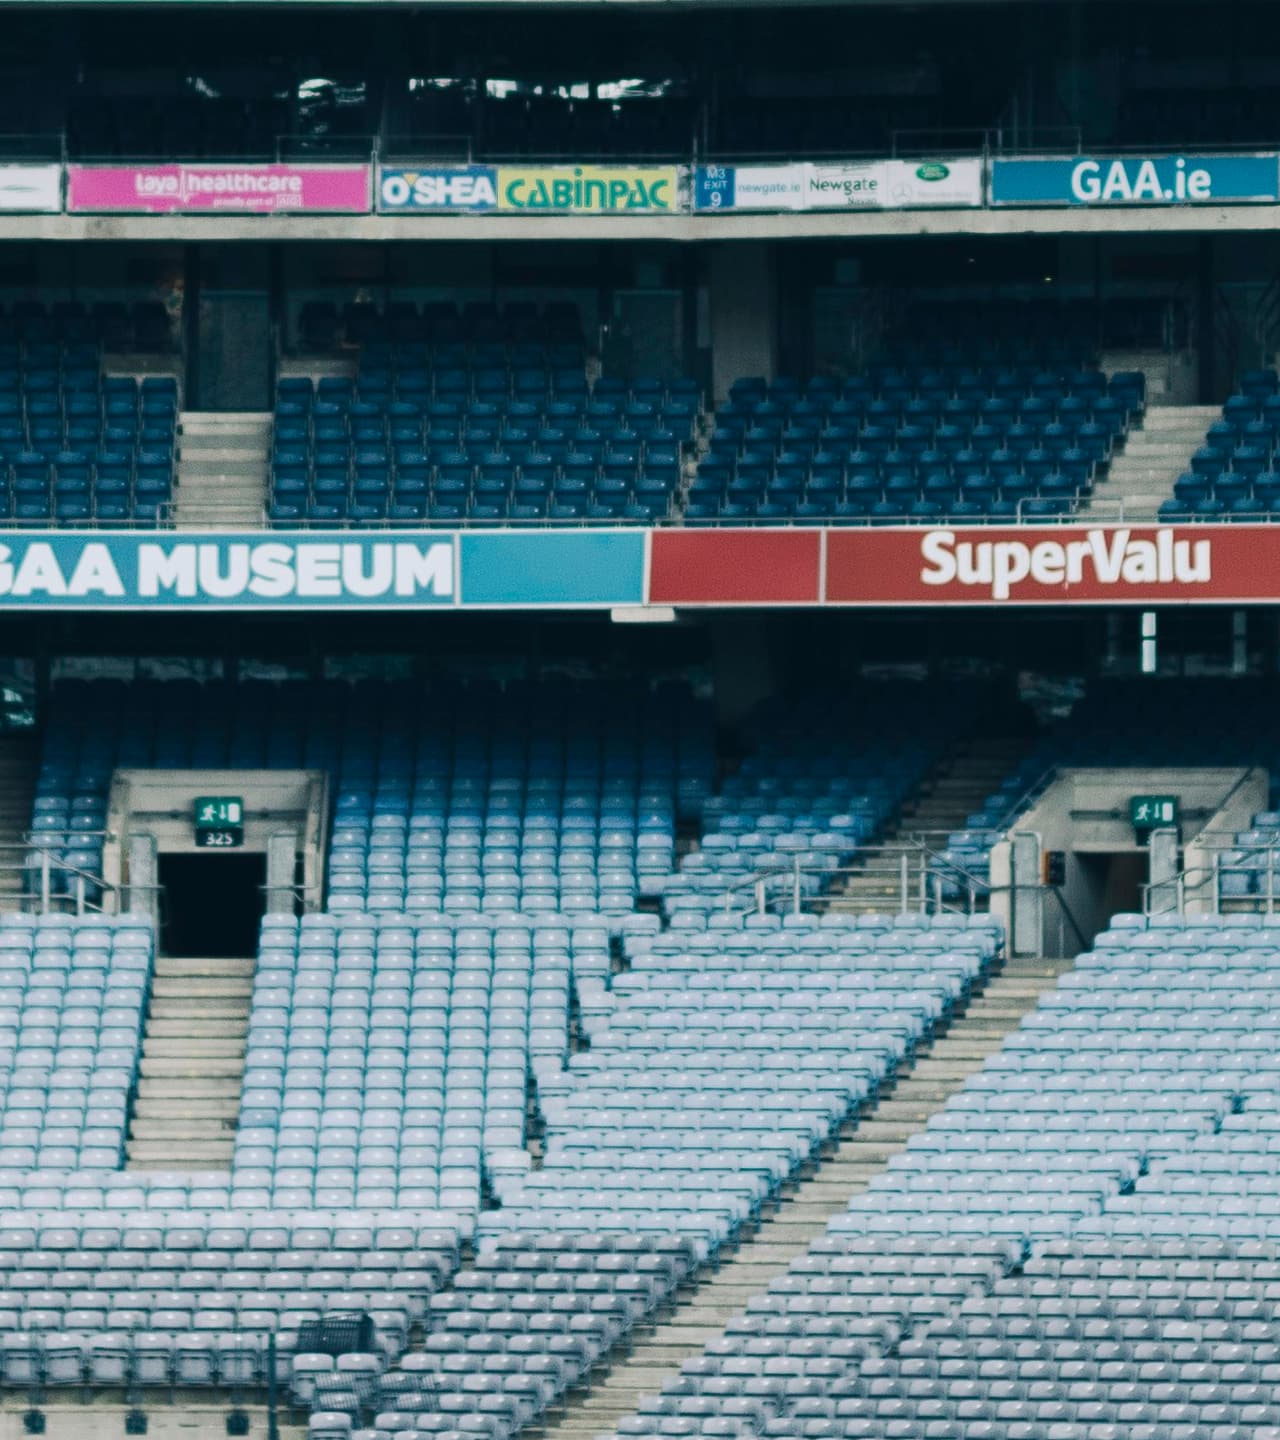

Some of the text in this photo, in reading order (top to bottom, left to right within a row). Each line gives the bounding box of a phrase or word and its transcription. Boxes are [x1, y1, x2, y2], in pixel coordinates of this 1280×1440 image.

[135, 172, 302, 195] laya healthcare
[704, 180, 728, 190] EXIT
[738, 182, 801, 195] newgate.ie
[809, 177, 878, 195] Newgate
[1071, 158, 1212, 201] GAA.ie
[138, 543, 454, 597] MUSEUM
[921, 528, 1211, 600] SuperValu
[206, 832, 233, 845] 325
